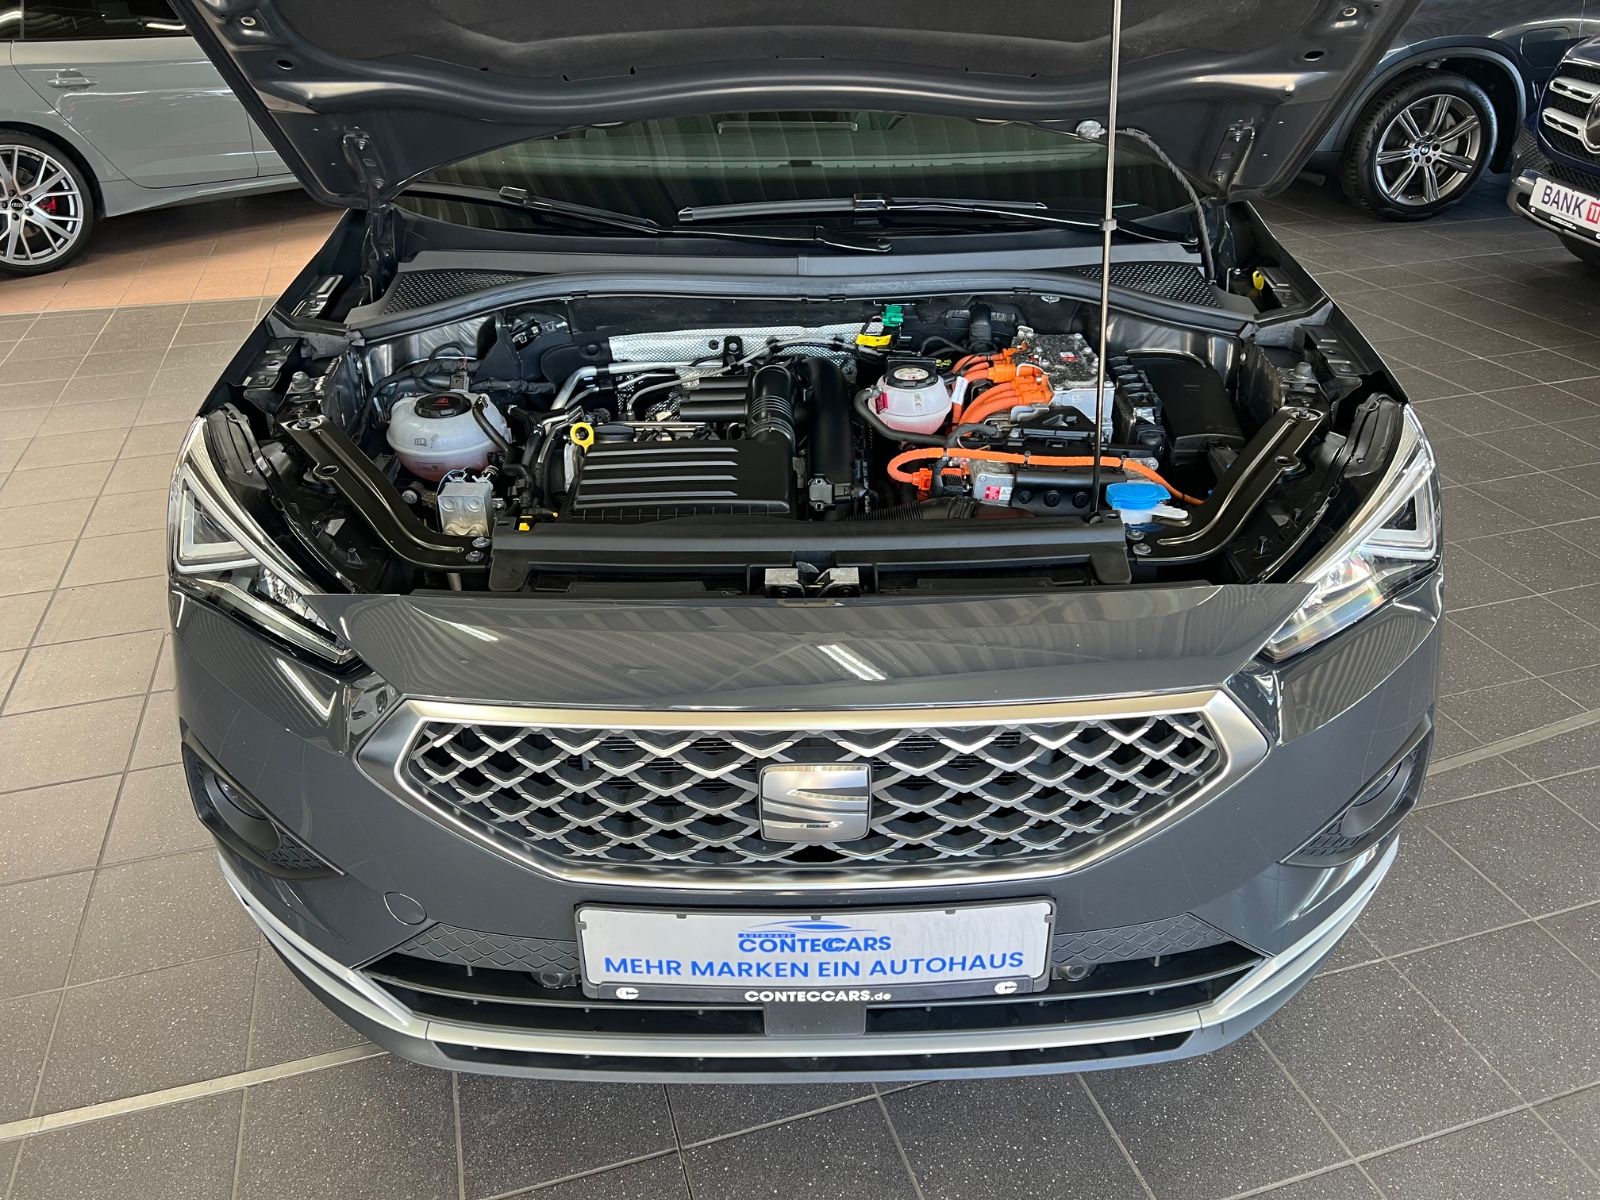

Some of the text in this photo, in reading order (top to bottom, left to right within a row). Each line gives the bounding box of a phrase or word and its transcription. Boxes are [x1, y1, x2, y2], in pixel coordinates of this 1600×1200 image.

[1541, 184, 1587, 219] BANK
[738, 936, 892, 953] CONTECCARS
[604, 952, 1024, 978] MEHR MARKEN EIN AUTOHAUS
[744, 990, 892, 1002] CONTECCARS.de
